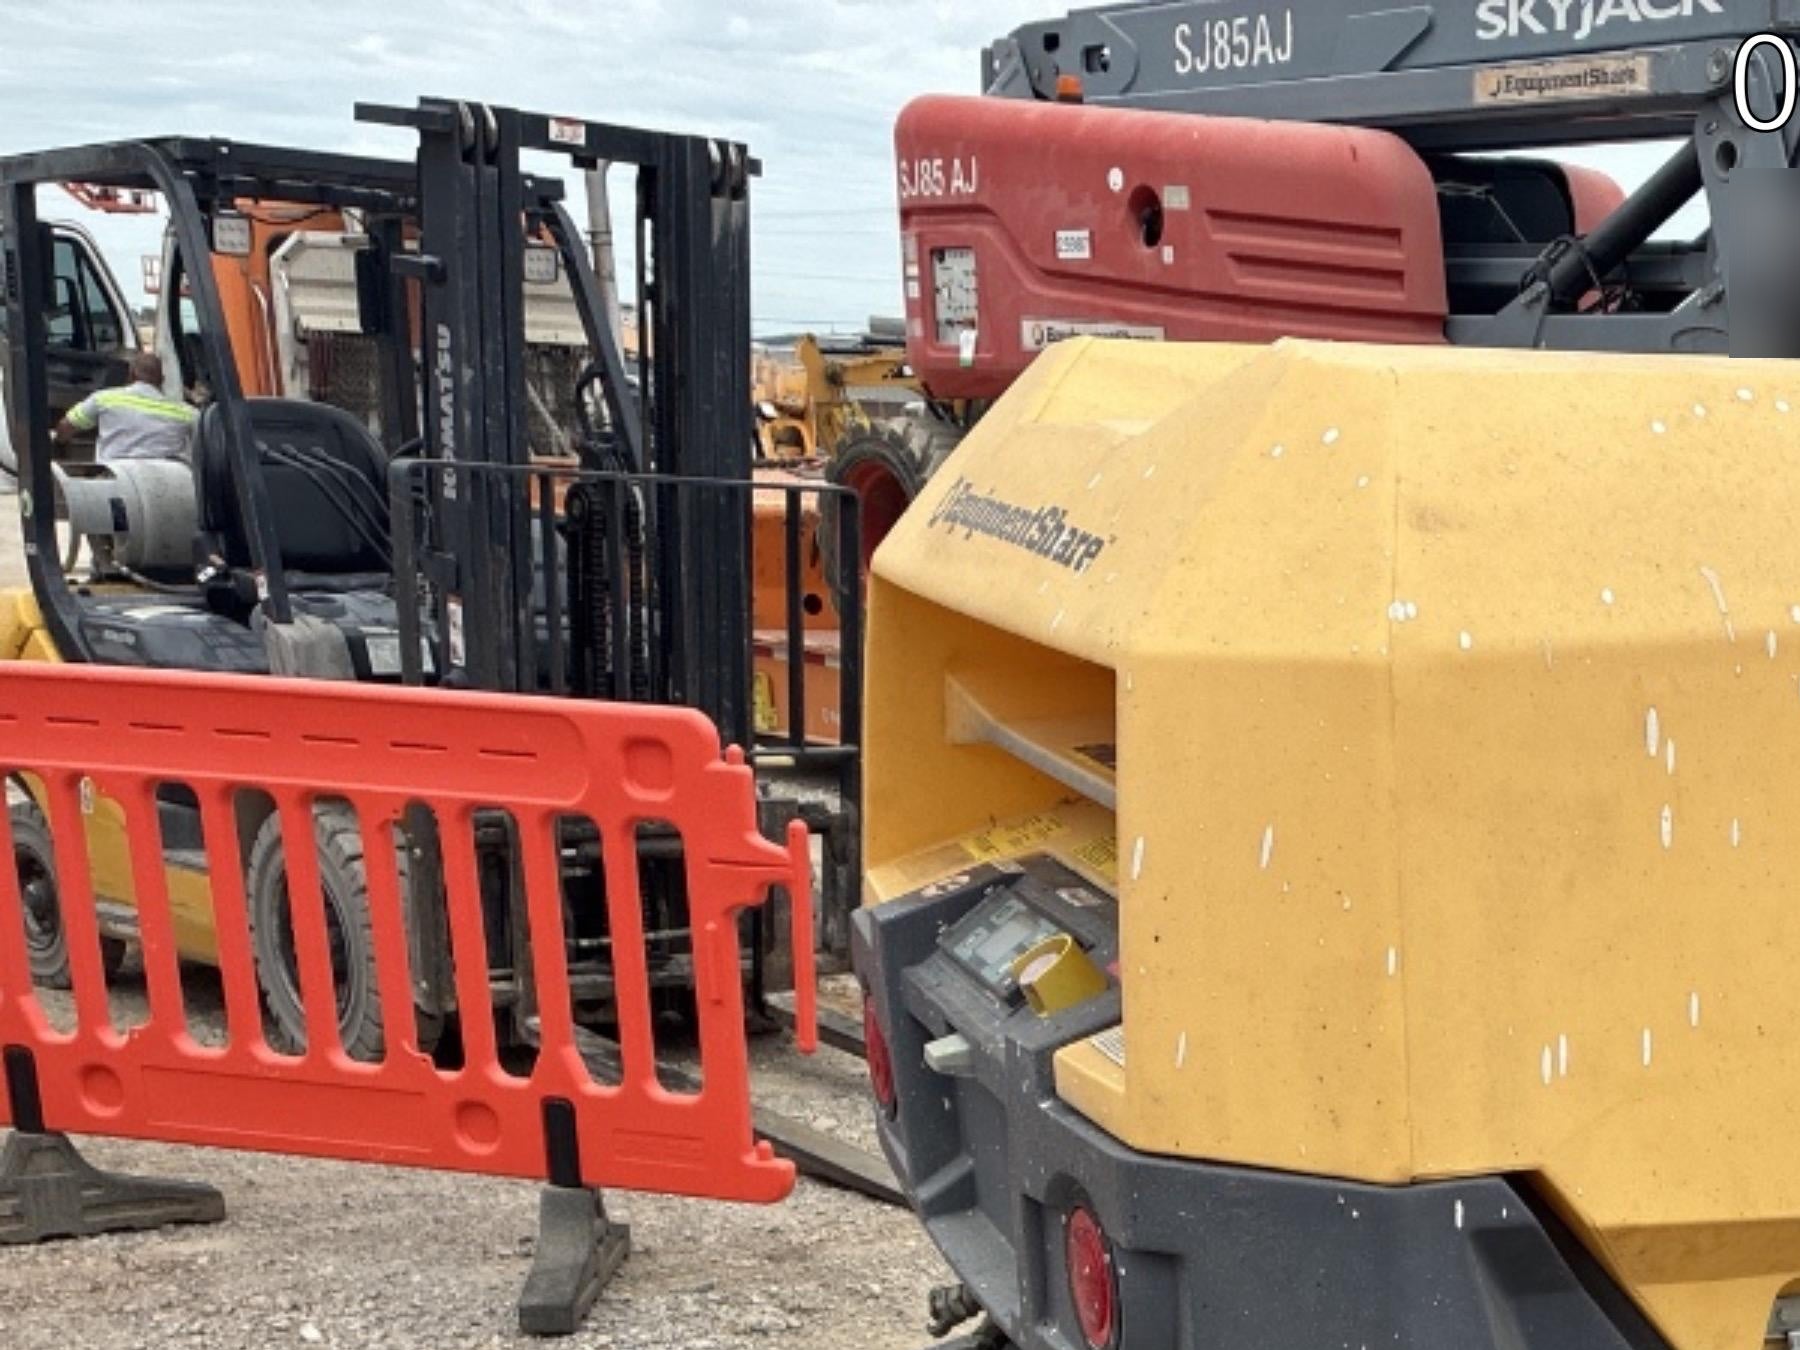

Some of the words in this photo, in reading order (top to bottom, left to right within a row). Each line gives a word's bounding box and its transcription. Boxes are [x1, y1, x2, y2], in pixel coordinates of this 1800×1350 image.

[1174, 9, 1292, 74] SJ85AJ
[900, 157, 945, 198] SJ85
[950, 155, 977, 194] AJ
[436, 322, 458, 500] KOMATSU
[941, 481, 1105, 572] EquipmentShare
